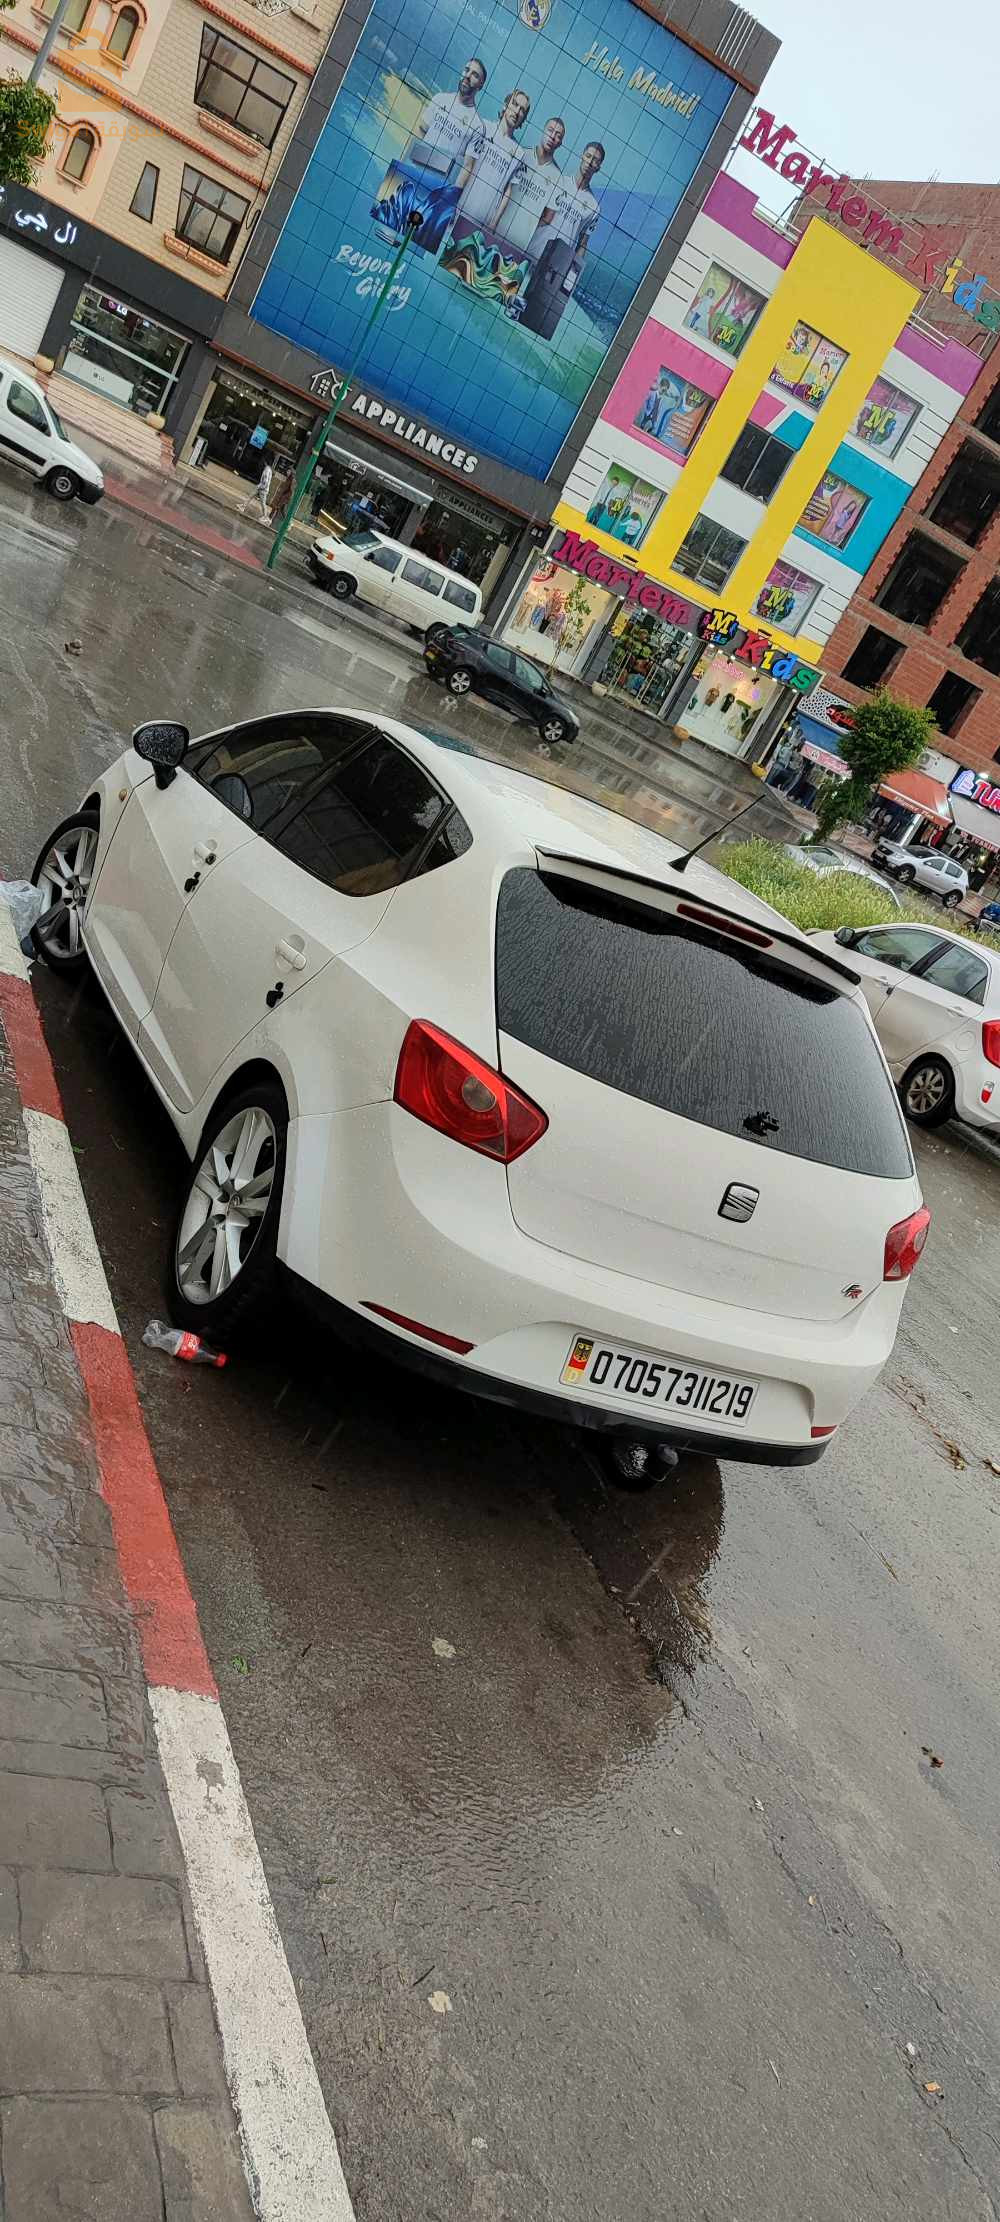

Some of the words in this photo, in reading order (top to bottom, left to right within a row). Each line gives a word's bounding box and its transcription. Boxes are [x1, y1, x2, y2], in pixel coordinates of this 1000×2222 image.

[581, 41, 624, 83] Hala
[628, 66, 700, 120] Madrid!
[740, 107, 904, 254] Mariem
[906, 241, 1000, 332] Kids
[352, 394, 479, 473] APPLIANCES
[554, 529, 693, 625] Mariem
[736, 629, 819, 692] Kids
[589, 1350, 754, 1419] 07057311219
